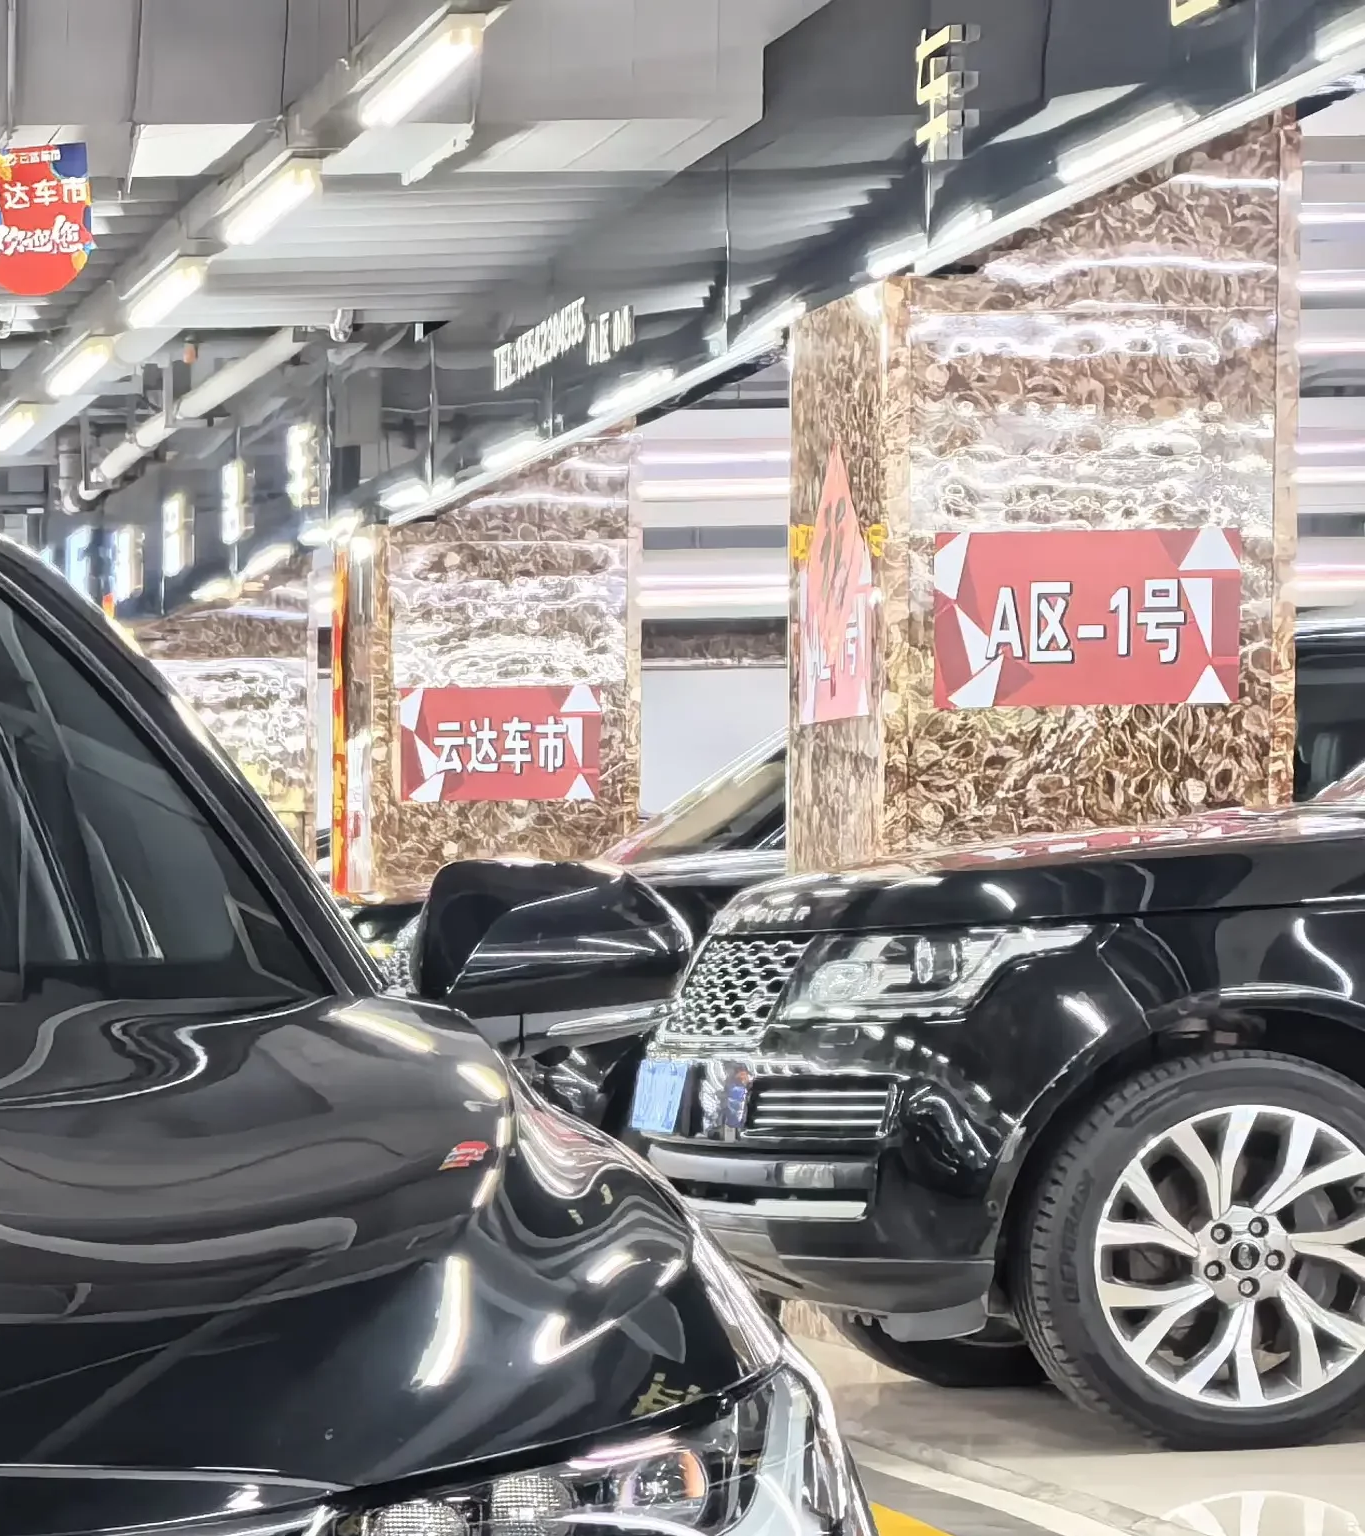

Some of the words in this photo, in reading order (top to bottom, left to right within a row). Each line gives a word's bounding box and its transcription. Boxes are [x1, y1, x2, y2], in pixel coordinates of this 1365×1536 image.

[985, 579, 1186, 663] A区-1号
[433, 715, 567, 776] 云达车市
